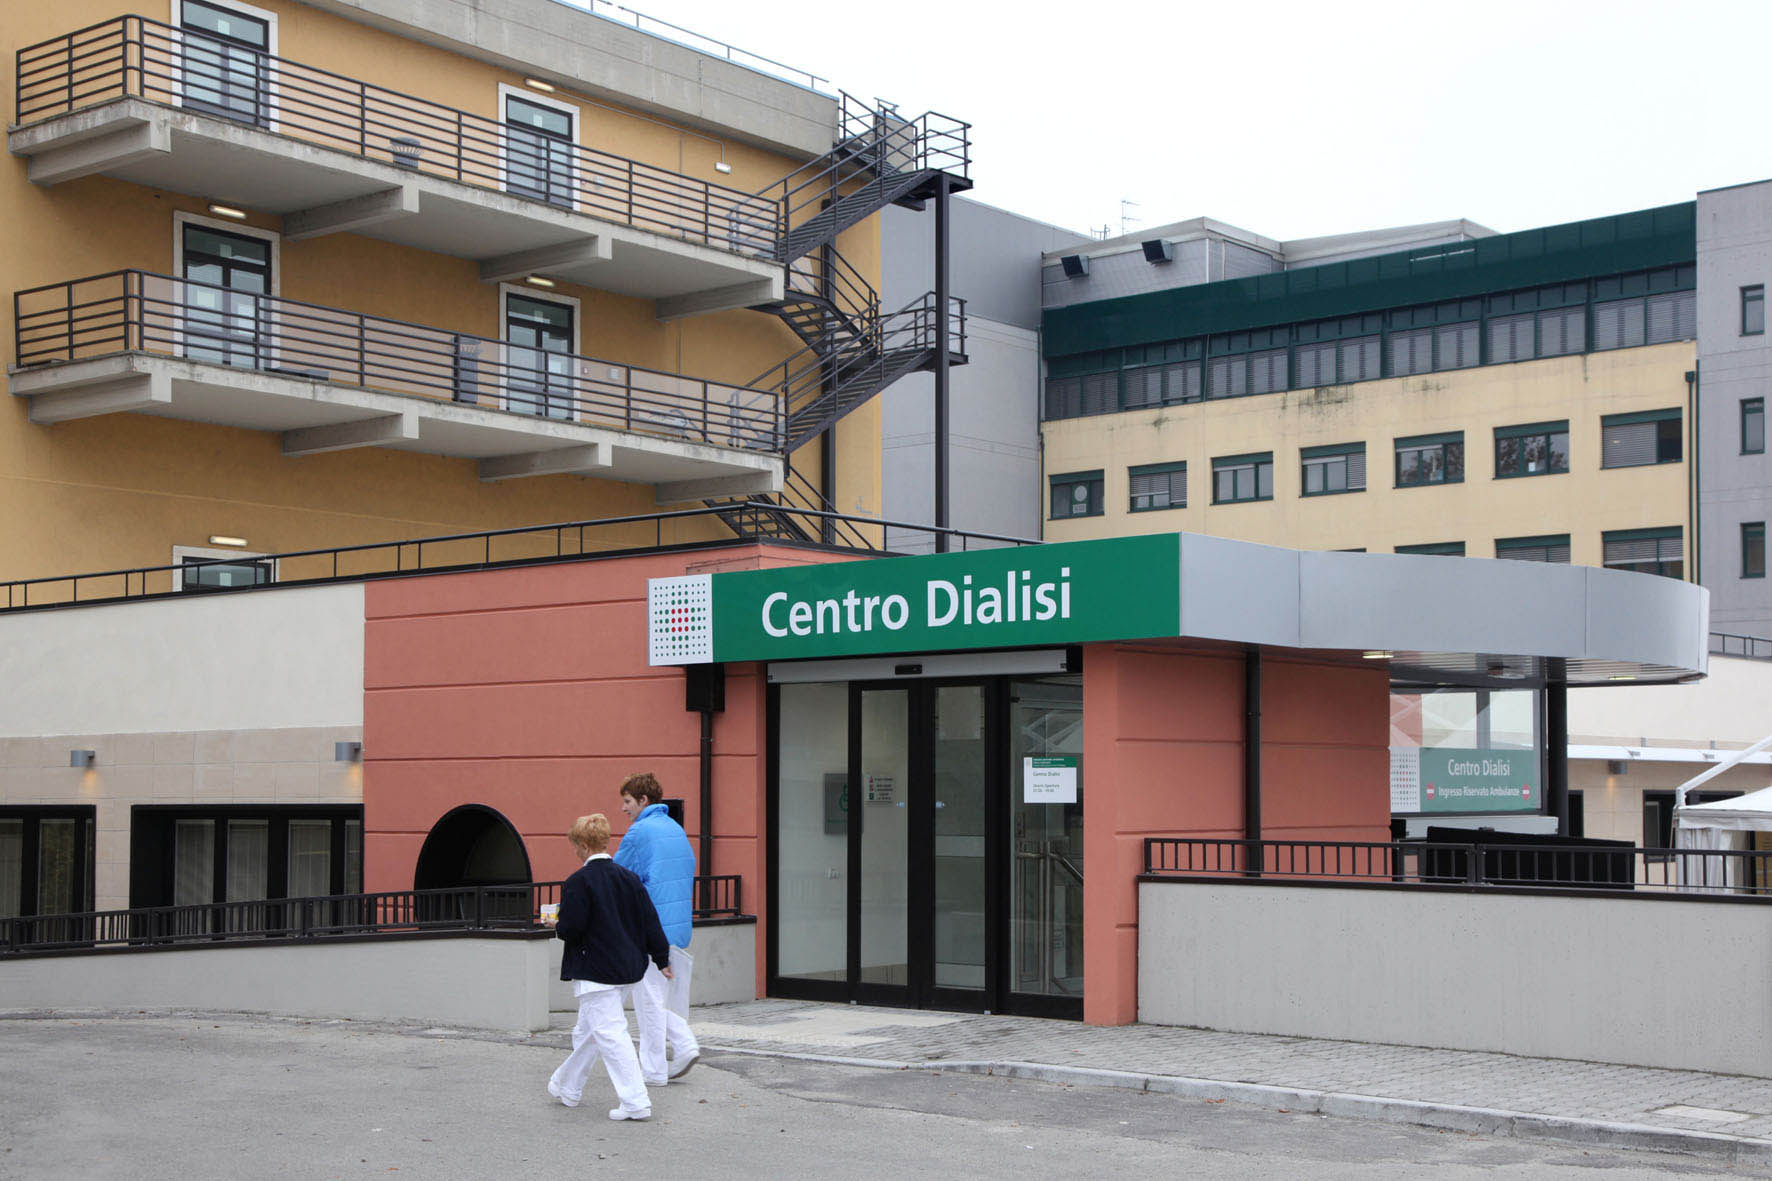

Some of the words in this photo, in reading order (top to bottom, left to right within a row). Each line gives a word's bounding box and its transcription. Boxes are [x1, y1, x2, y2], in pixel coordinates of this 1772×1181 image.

[761, 589, 909, 638] Centro
[927, 566, 1071, 628] Dialisi
[1448, 759, 1480, 776] Centro
[1482, 759, 1510, 776] Dialisi
[1438, 786, 1462, 799] Ingresso
[1463, 786, 1489, 797] Riservato
[1490, 786, 1520, 797] Ambulanze
